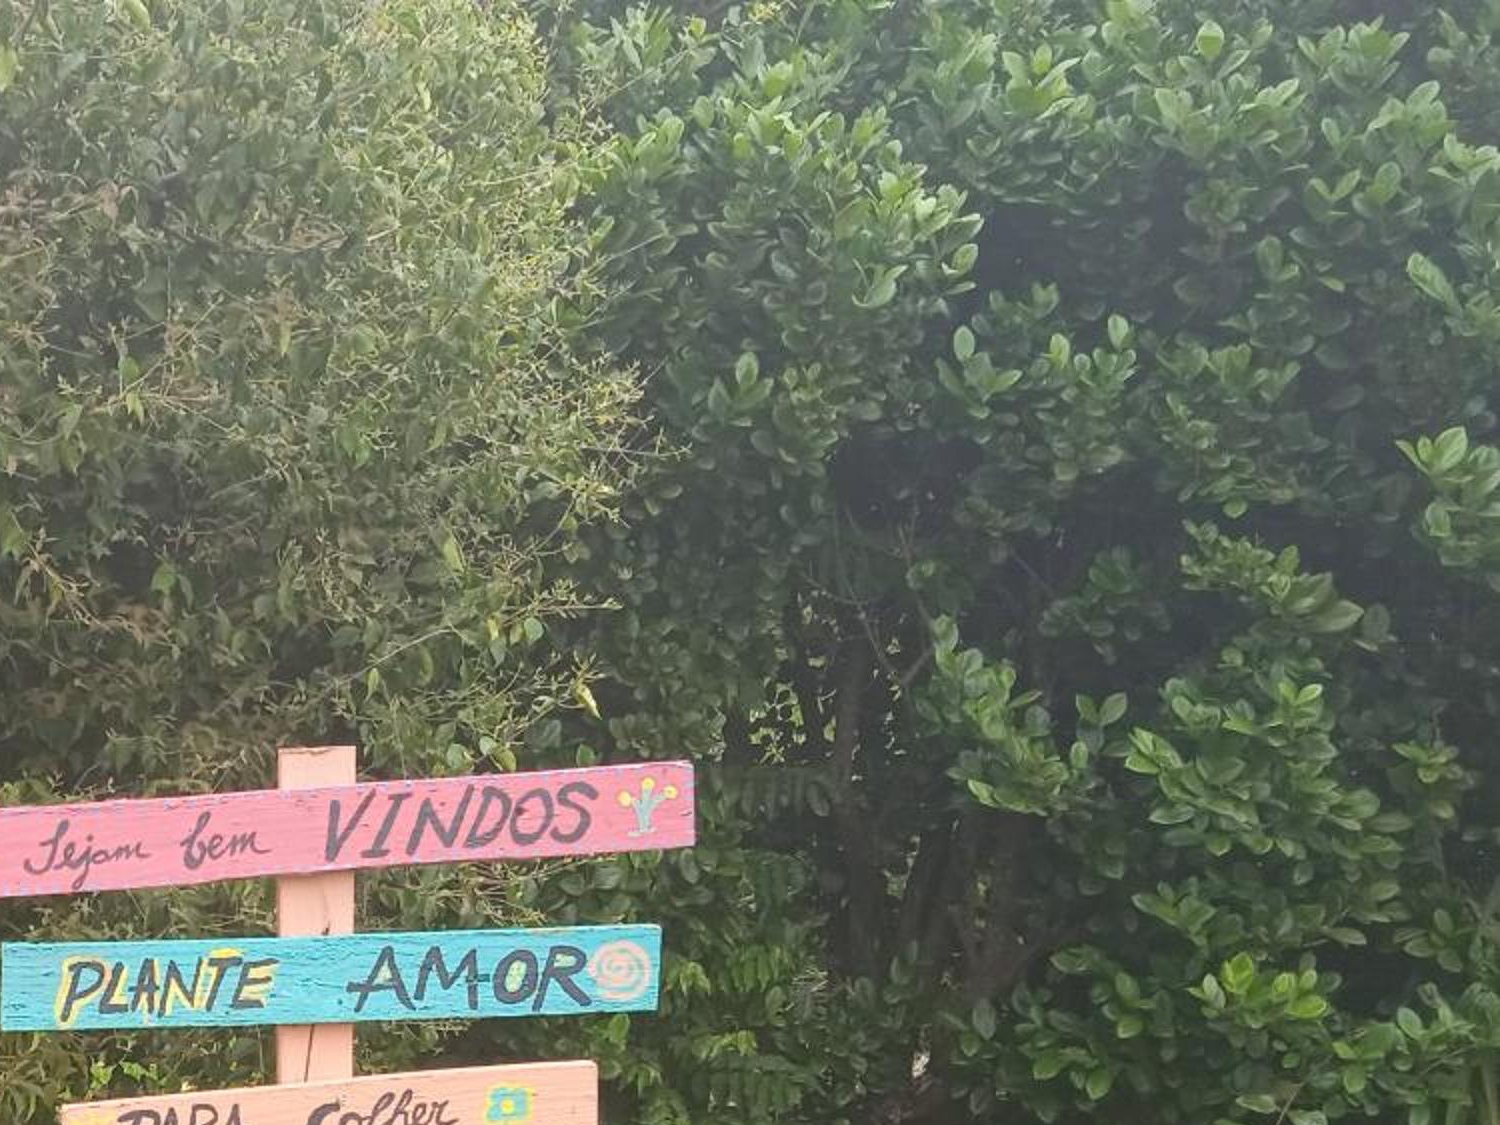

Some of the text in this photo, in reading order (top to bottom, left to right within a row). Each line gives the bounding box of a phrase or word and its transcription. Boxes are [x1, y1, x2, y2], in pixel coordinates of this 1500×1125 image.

[23, 781, 601, 890] Sejam bem VINDOS
[60, 945, 589, 1026] PLANTE AMOR
